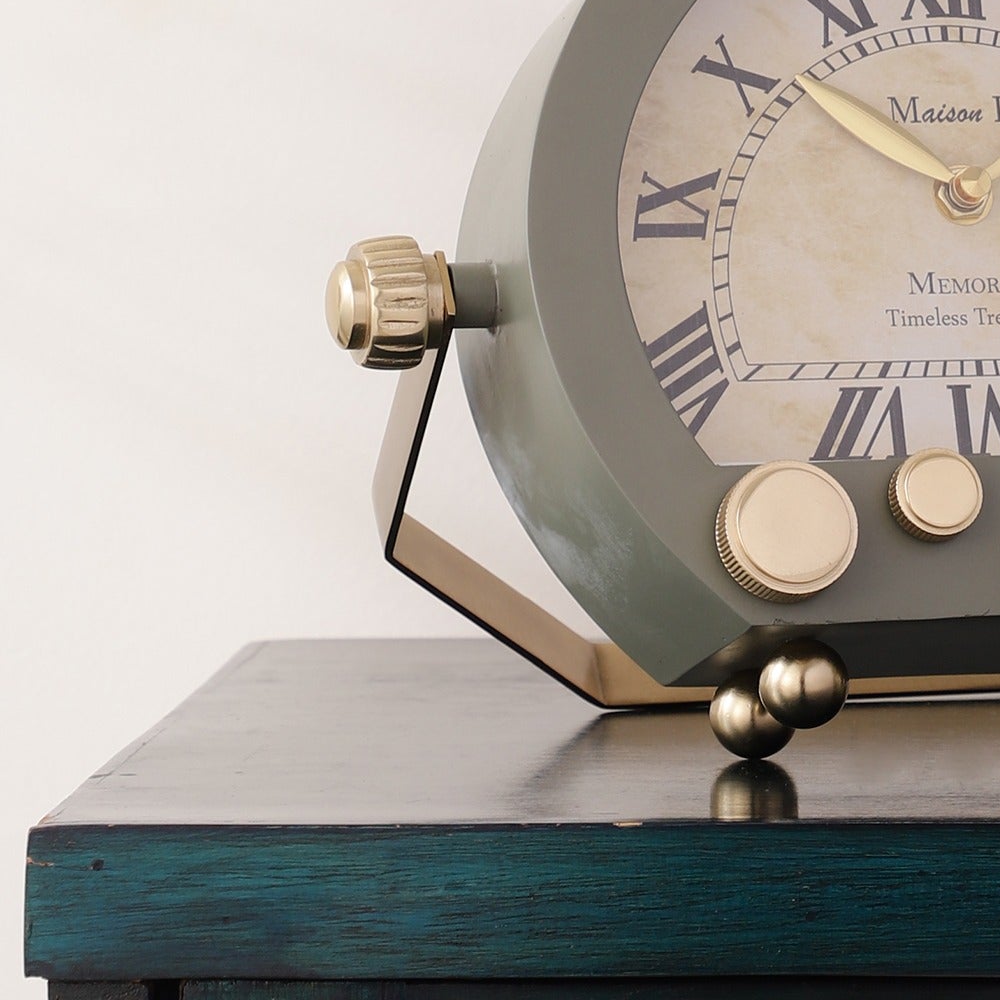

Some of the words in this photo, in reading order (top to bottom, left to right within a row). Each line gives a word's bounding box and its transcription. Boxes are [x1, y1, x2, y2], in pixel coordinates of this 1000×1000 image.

[691, 34, 781, 117] X
[887, 96, 983, 123] Maison
[633, 168, 722, 242] IX
[885, 306, 968, 327] Timeless
